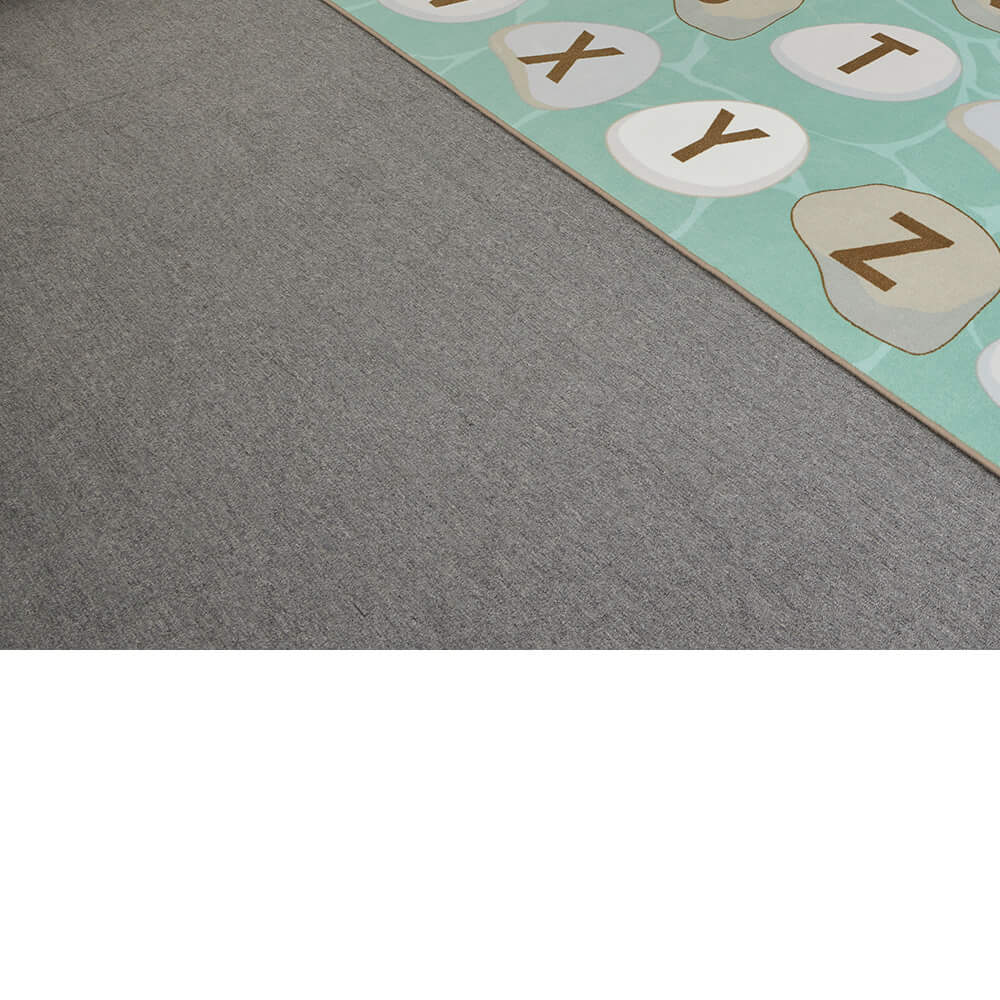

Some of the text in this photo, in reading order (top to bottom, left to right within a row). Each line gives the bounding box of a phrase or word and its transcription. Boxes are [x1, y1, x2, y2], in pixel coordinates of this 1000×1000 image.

[517, 30, 625, 84] X
[837, 32, 919, 75] T
[671, 108, 769, 163] Y
[829, 211, 955, 292] Z
